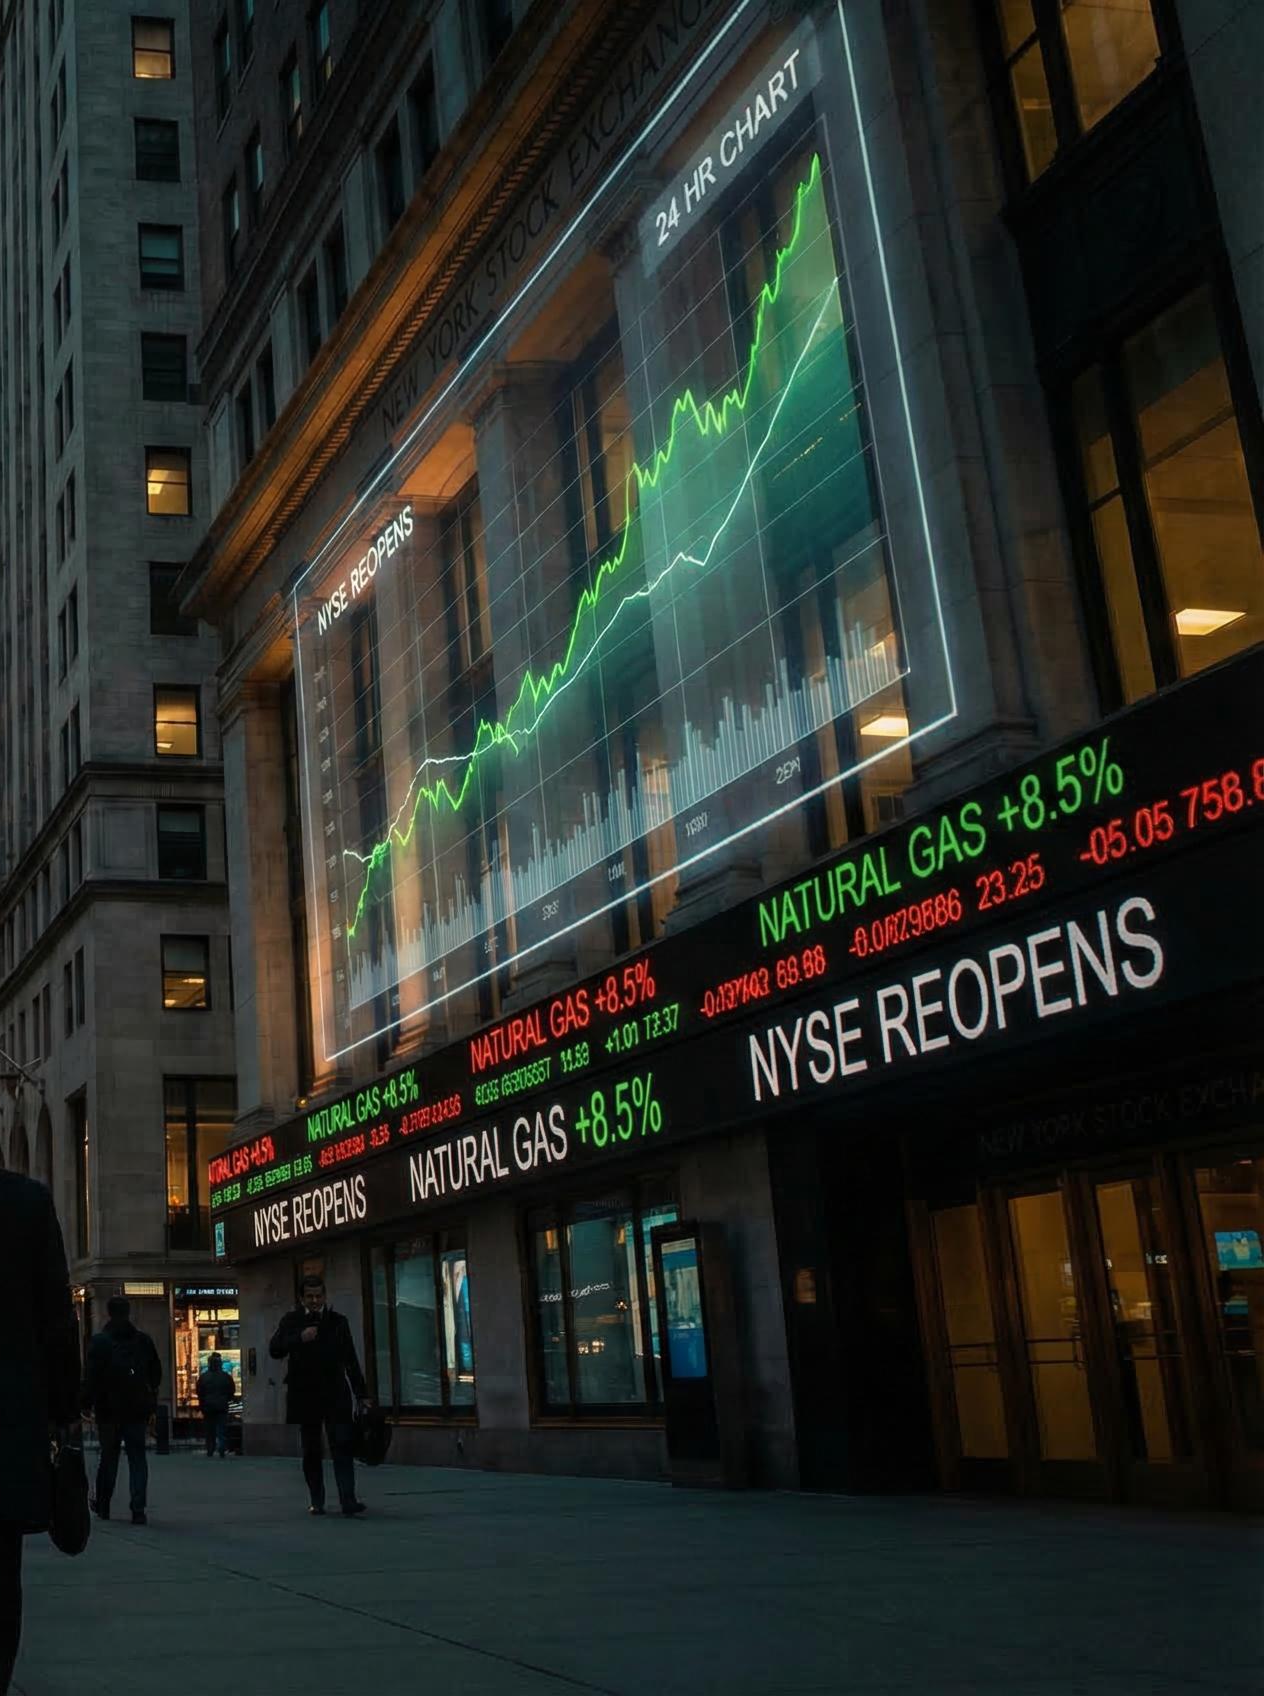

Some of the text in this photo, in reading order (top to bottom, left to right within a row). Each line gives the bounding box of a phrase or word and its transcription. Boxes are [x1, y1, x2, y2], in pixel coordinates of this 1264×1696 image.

[654, 48, 801, 248] 24 HR CHART
[380, 369, 420, 440] NEW
[426, 290, 480, 379] YORK
[485, 169, 561, 298] STOCK
[317, 585, 349, 636] NYSE
[350, 505, 415, 597] REOPENS
[758, 737, 1124, 947] NATURAL GAS +8.5%
[470, 958, 656, 1074] NATURAL GAS +8.5%
[747, 896, 1164, 1101] NYSE REOPENS
[307, 1099, 356, 1143] NATURAL
[356, 1085, 381, 1123] GAS
[409, 1134, 510, 1204] NATURAL
[512, 1104, 569, 1168] GAS
[575, 1072, 663, 1149] +8.5%
[254, 1194, 291, 1248] NYSE
[292, 1173, 368, 1239] REOPENS
